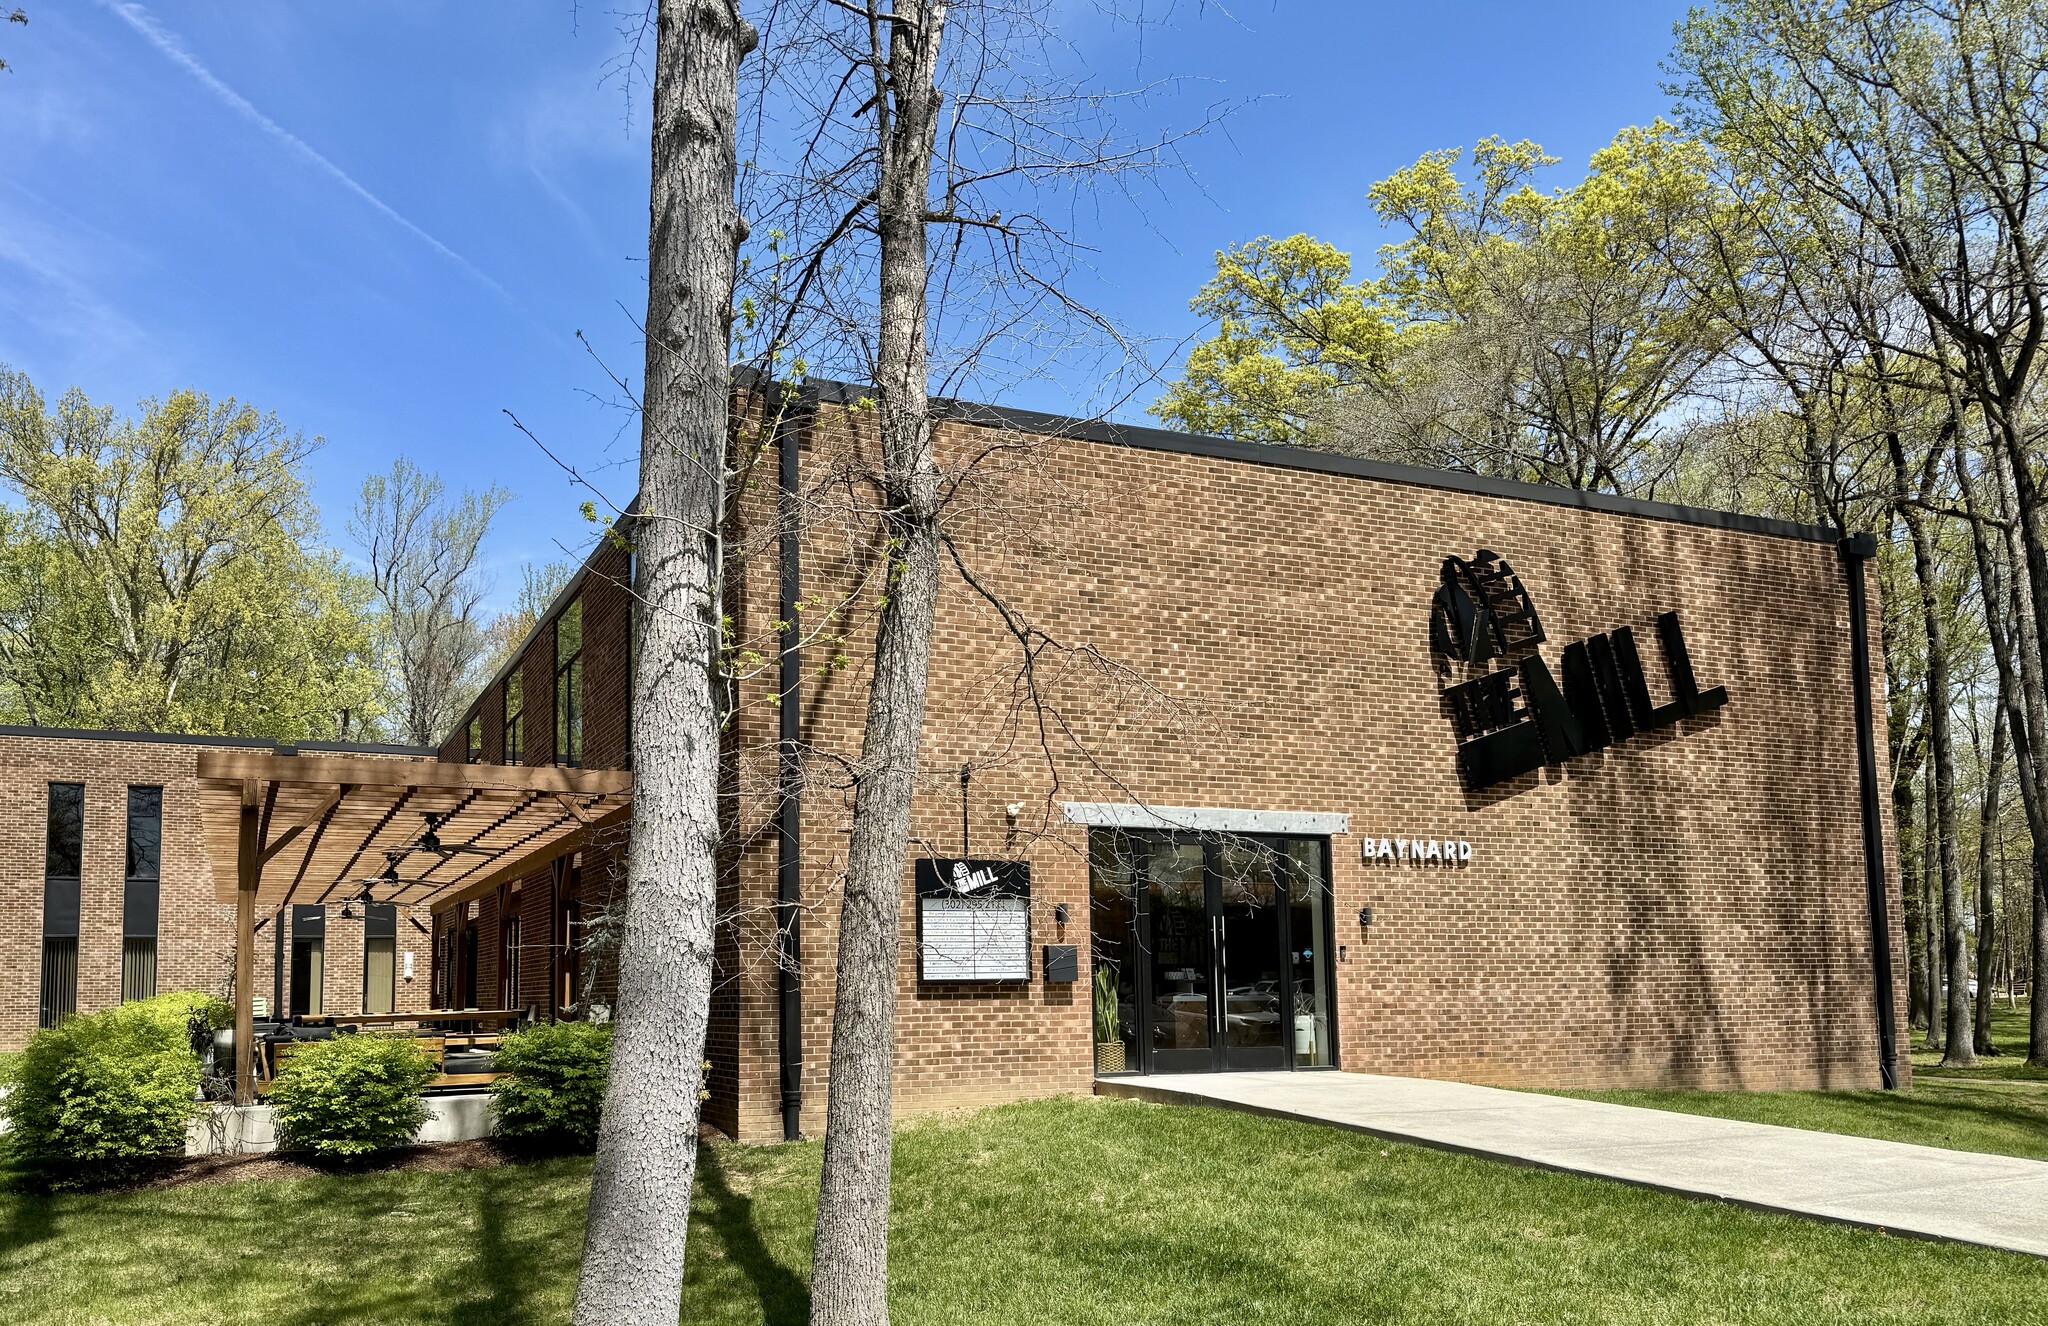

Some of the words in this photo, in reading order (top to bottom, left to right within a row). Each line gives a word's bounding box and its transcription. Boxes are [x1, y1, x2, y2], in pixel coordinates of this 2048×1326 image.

[1443, 667, 1528, 740] THE
[1521, 610, 1729, 766] MILL
[1362, 837, 1473, 860] BAYNARD
[966, 866, 999, 891] MILL
[1158, 936, 1179, 952] THE
